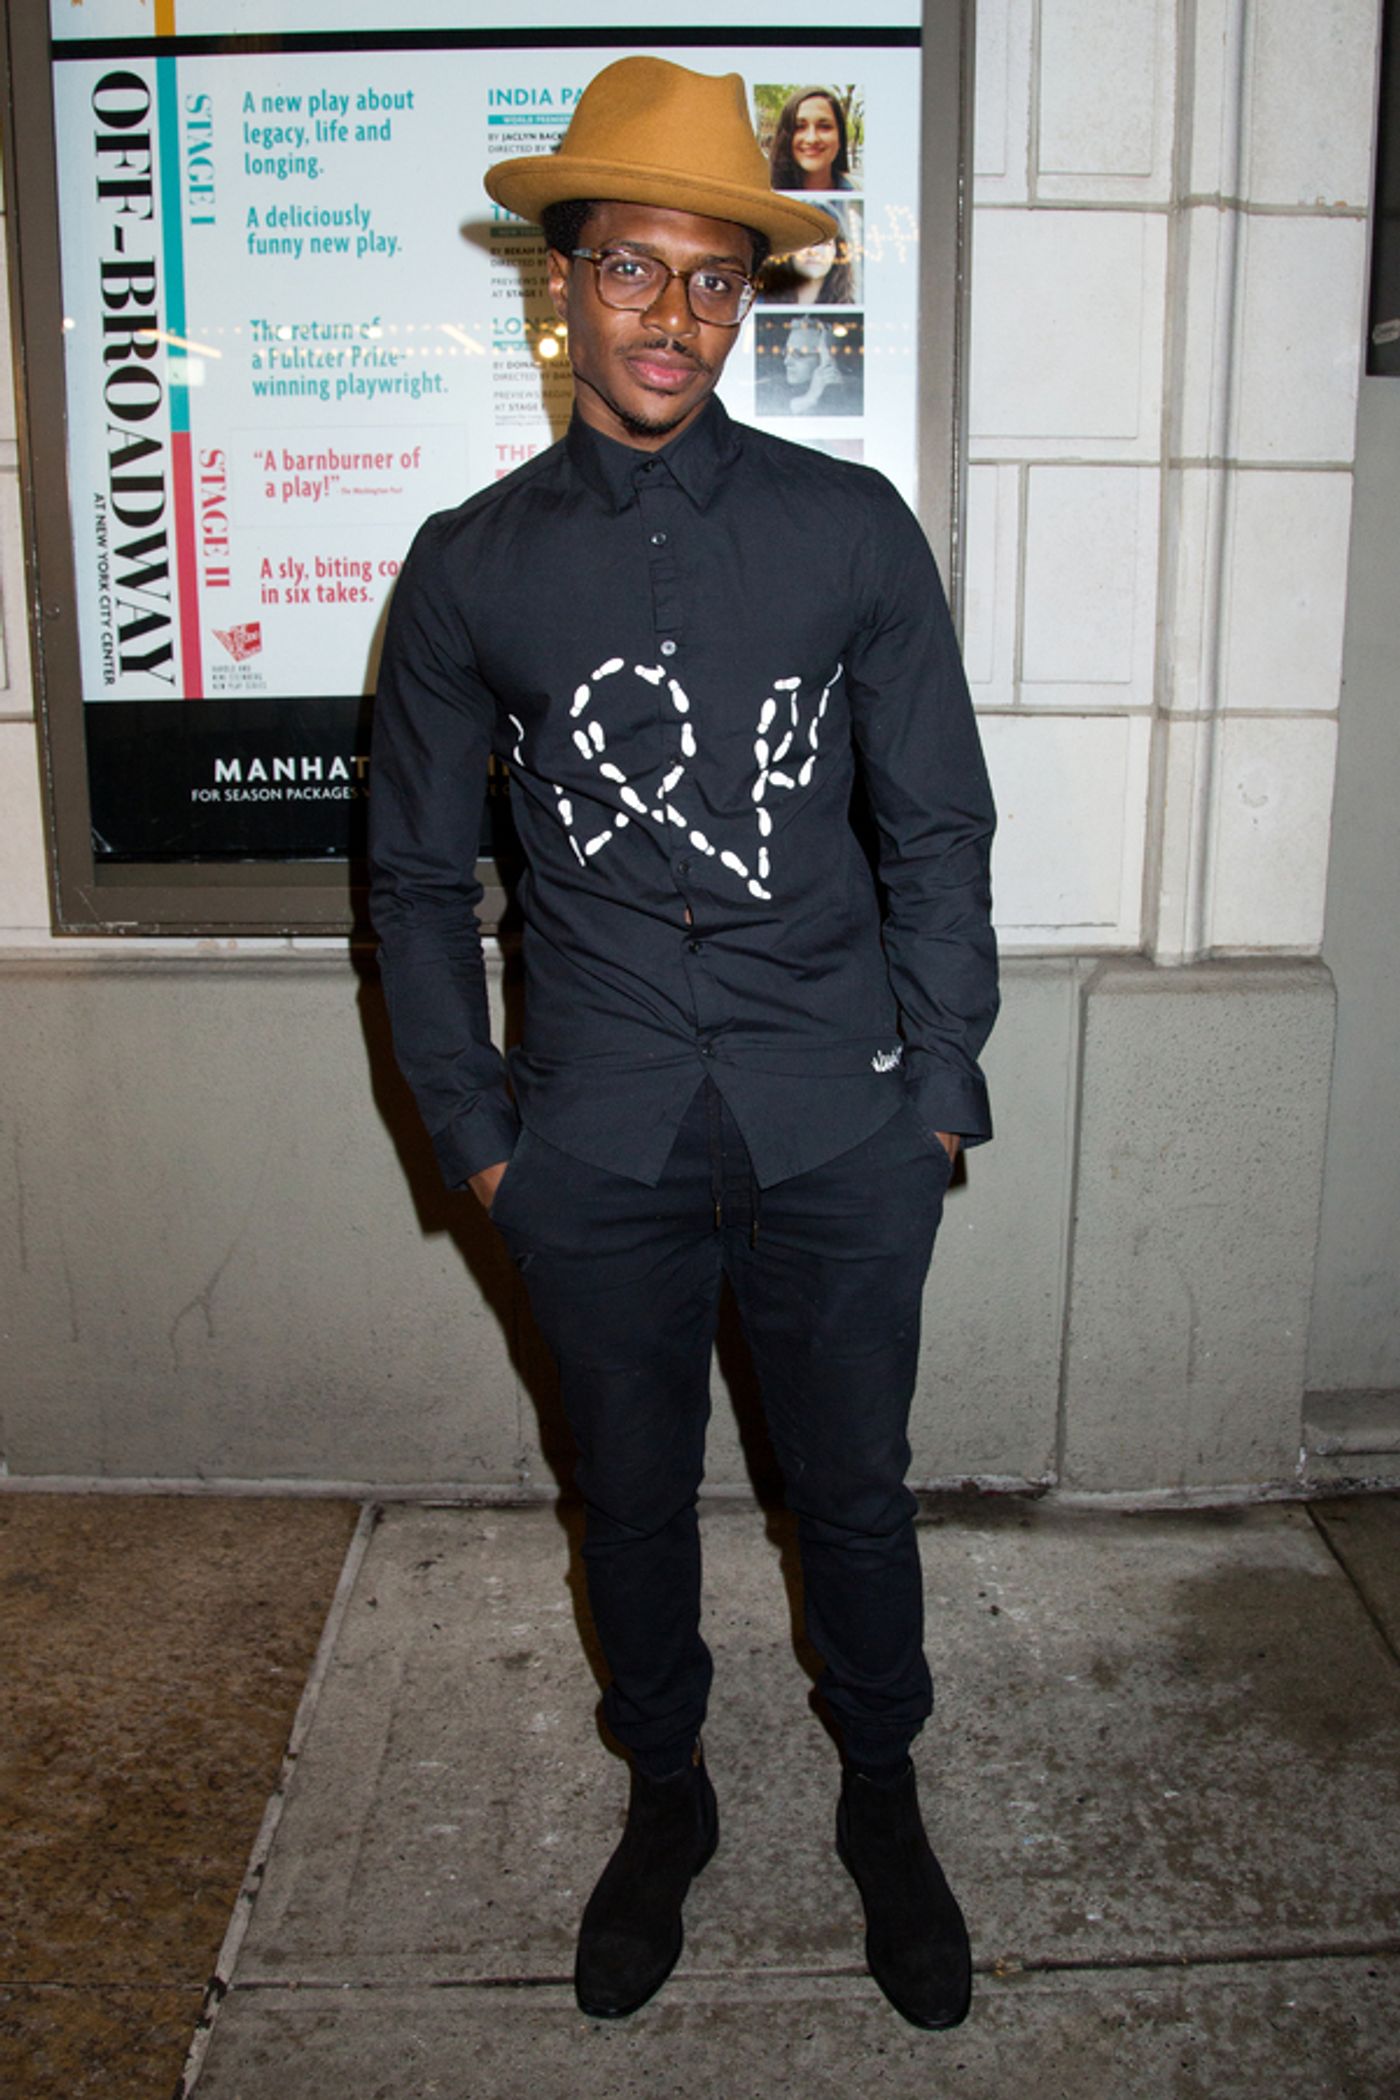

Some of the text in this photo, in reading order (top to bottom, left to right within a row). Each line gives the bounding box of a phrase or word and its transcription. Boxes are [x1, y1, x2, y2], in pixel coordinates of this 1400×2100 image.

[242, 87, 414, 118] A new play about
[488, 88, 554, 107] INDIA
[244, 118, 391, 149] legacy, life and
[186, 93, 216, 206] STAGE
[244, 151, 324, 180] longing.
[246, 202, 371, 231] A deliciously
[247, 229, 402, 259] funny new play.
[292, 321, 353, 341] return
[252, 353, 262, 370] a
[91, 70, 176, 686] OFF-BROADWAY
[252, 370, 448, 401] winning playwright.
[282, 447, 393, 470] barnburner
[400, 446, 421, 469] of
[265, 481, 275, 498] a
[200, 448, 231, 587] STAGE II
[260, 558, 273, 579] A
[279, 556, 309, 586] sly,
[315, 556, 372, 582] biting
[94, 492, 116, 686] AT NEW YORK CITY CENTER
[261, 580, 374, 604] in six takes.
[191, 788, 220, 802] FOR
[224, 788, 283, 802] SEASON
